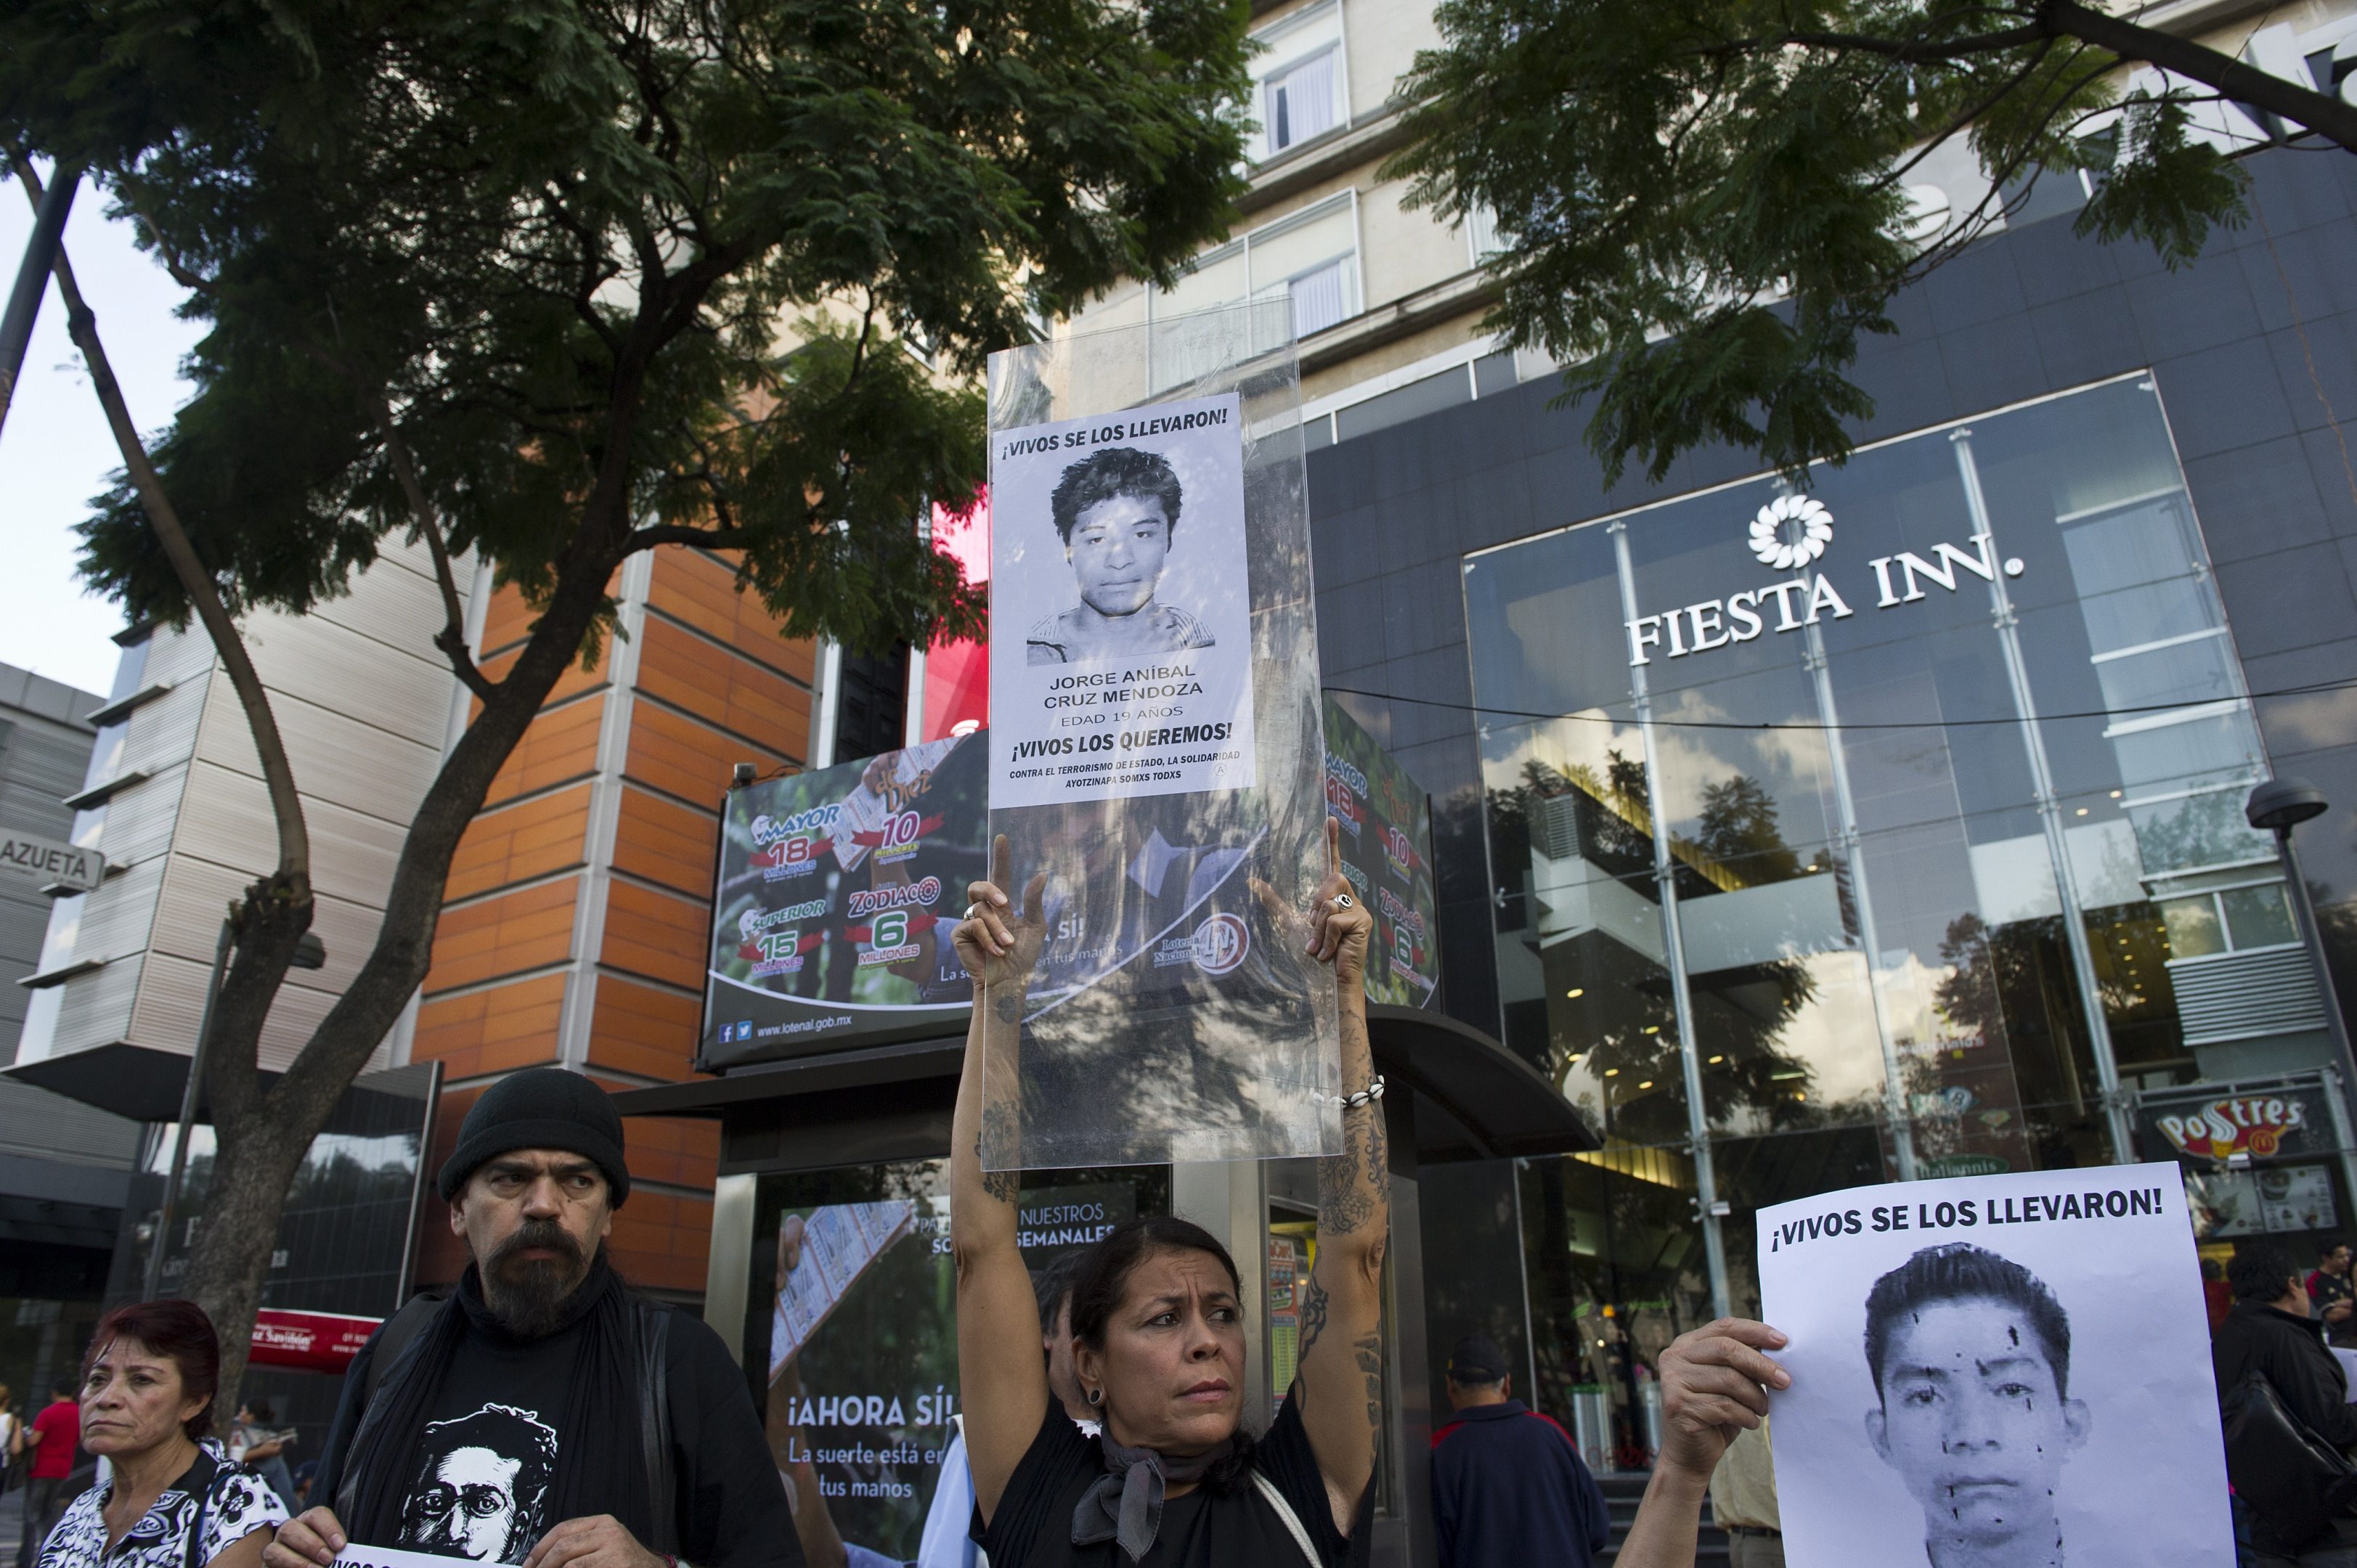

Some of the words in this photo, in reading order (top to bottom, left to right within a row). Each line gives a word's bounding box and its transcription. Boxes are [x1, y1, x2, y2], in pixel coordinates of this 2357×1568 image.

[1001, 435, 1059, 460] ¡VIVOS
[1064, 430, 1086, 448] SE
[1091, 425, 1125, 444] LOS
[1128, 408, 1229, 438] LLEVARON!
[1624, 572, 1854, 667] FIESTA
[1049, 672, 1118, 690] JORGE
[1122, 664, 1196, 683] ANÍBAL
[1043, 693, 1099, 709] CRUZ
[1102, 682, 1203, 703] MENDOZA
[1061, 714, 1106, 727] EDAD
[1112, 711, 1131, 722] 19
[1136, 706, 1184, 719] AÑOS
[1011, 736, 1073, 762] ¡VIVOS
[1078, 733, 1115, 754] LOS
[1119, 722, 1233, 751] QUEREMOS!
[1009, 769, 1043, 779] CONTRA
[1045, 767, 1056, 776] EL
[1057, 761, 1113, 775] TERRORISMO
[1115, 761, 1128, 770] DE
[1128, 758, 1166, 769] ESTADO,
[1167, 756, 1179, 766] LA
[1180, 751, 1240, 764] SOLIDARIDAD
[1065, 776, 1118, 788] AYOTZINAPA
[1119, 772, 1151, 784] SOMXS
[1152, 769, 1182, 781] TODXS
[1327, 775, 1354, 819] 18
[760, 805, 839, 842] MAYOR
[881, 811, 920, 848] 10
[0, 840, 86, 879] AZUETA
[768, 837, 810, 865] 18
[1390, 827, 1410, 867] 10
[1340, 859, 1369, 892] ERIOR
[752, 899, 826, 931] SUPERIOR
[872, 911, 908, 950] 6
[758, 931, 799, 960] 15
[858, 944, 920, 965] MILLONES
[1054, 951, 1075, 965] tus
[1078, 944, 1123, 960] manos
[1394, 925, 1413, 970] 6
[757, 1016, 852, 1037] www.lotenal.gob.mx
[1019, 1203, 1104, 1226] NUESTROS
[1771, 1209, 1862, 1252] ¡VIVOS
[1870, 1205, 1909, 1233] SE
[1918, 1201, 1978, 1229] LOS
[1987, 1188, 2163, 1225] LLEVARON!
[788, 1395, 906, 1426] ¡AHORA
[914, 1384, 953, 1426] SÍ!
[789, 1437, 811, 1463] La
[816, 1441, 875, 1463] suerte
[879, 1442, 919, 1464] está
[819, 1474, 846, 1497] tus
[851, 1482, 913, 1498] manos
